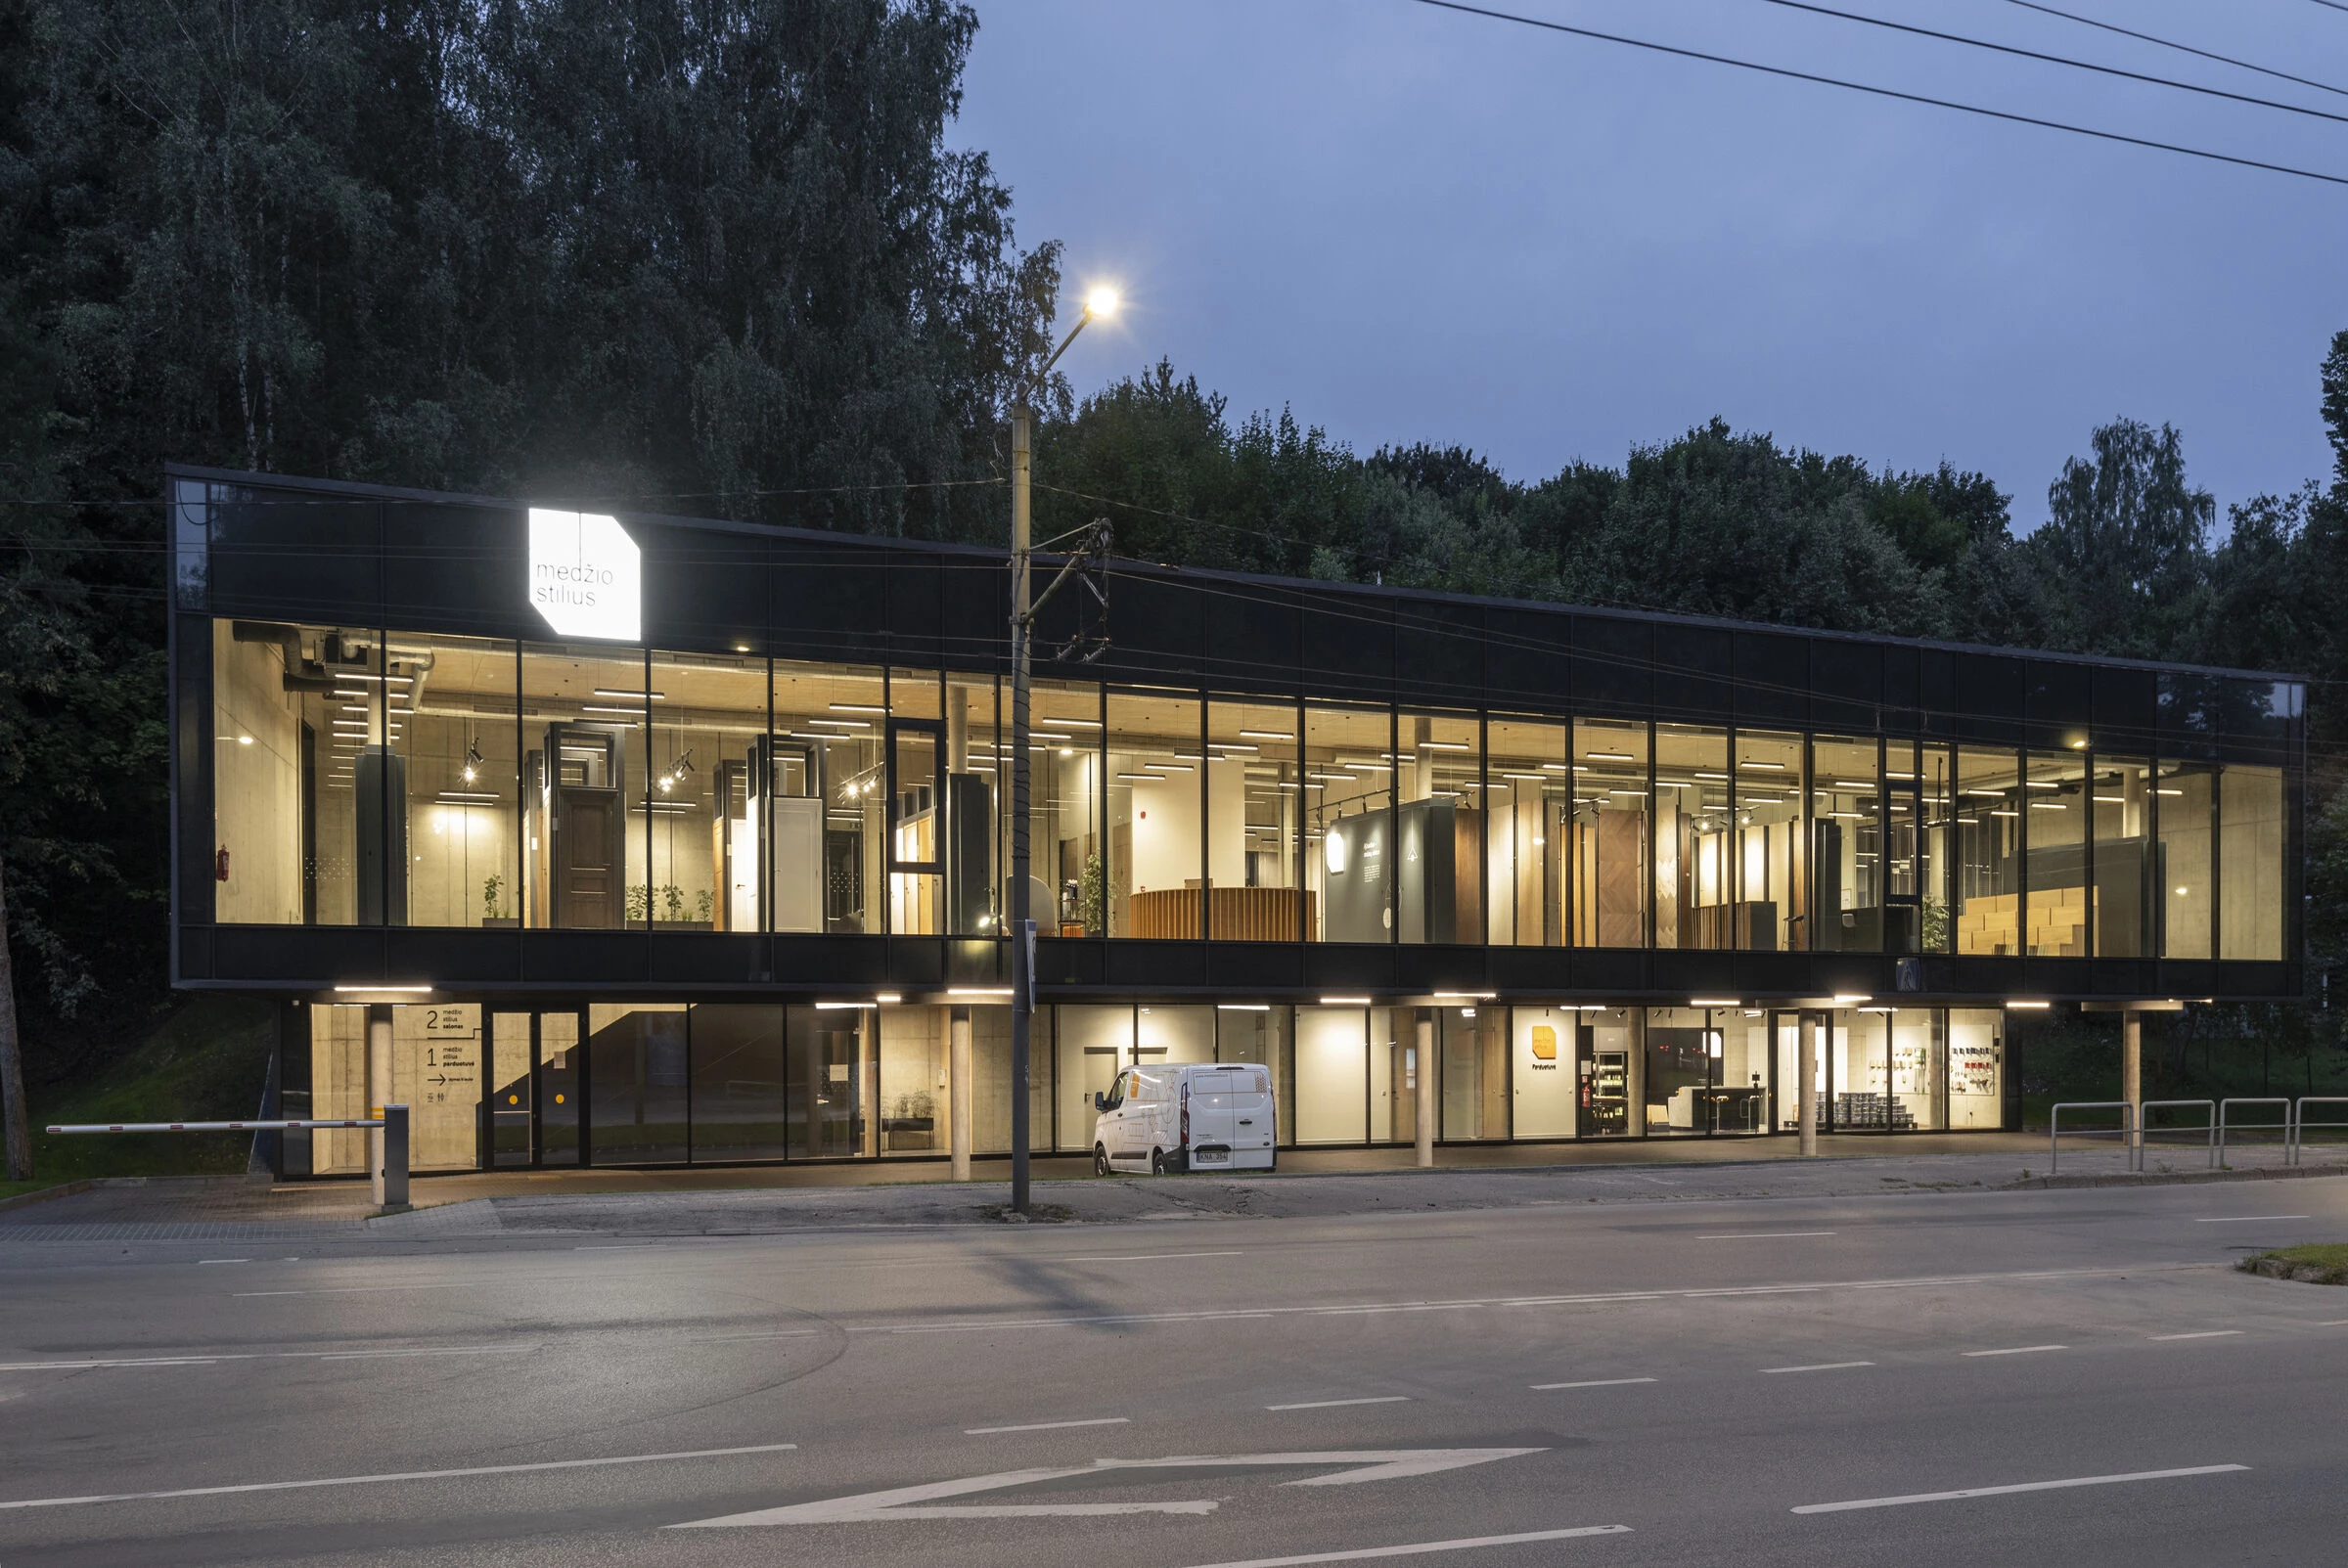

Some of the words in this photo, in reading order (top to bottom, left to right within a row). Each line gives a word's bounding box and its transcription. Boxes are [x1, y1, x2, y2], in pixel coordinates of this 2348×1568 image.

[536, 562, 613, 586] medžio
[536, 585, 596, 606] stilius
[427, 1010, 438, 1029] 2
[427, 1048, 436, 1066] 1
